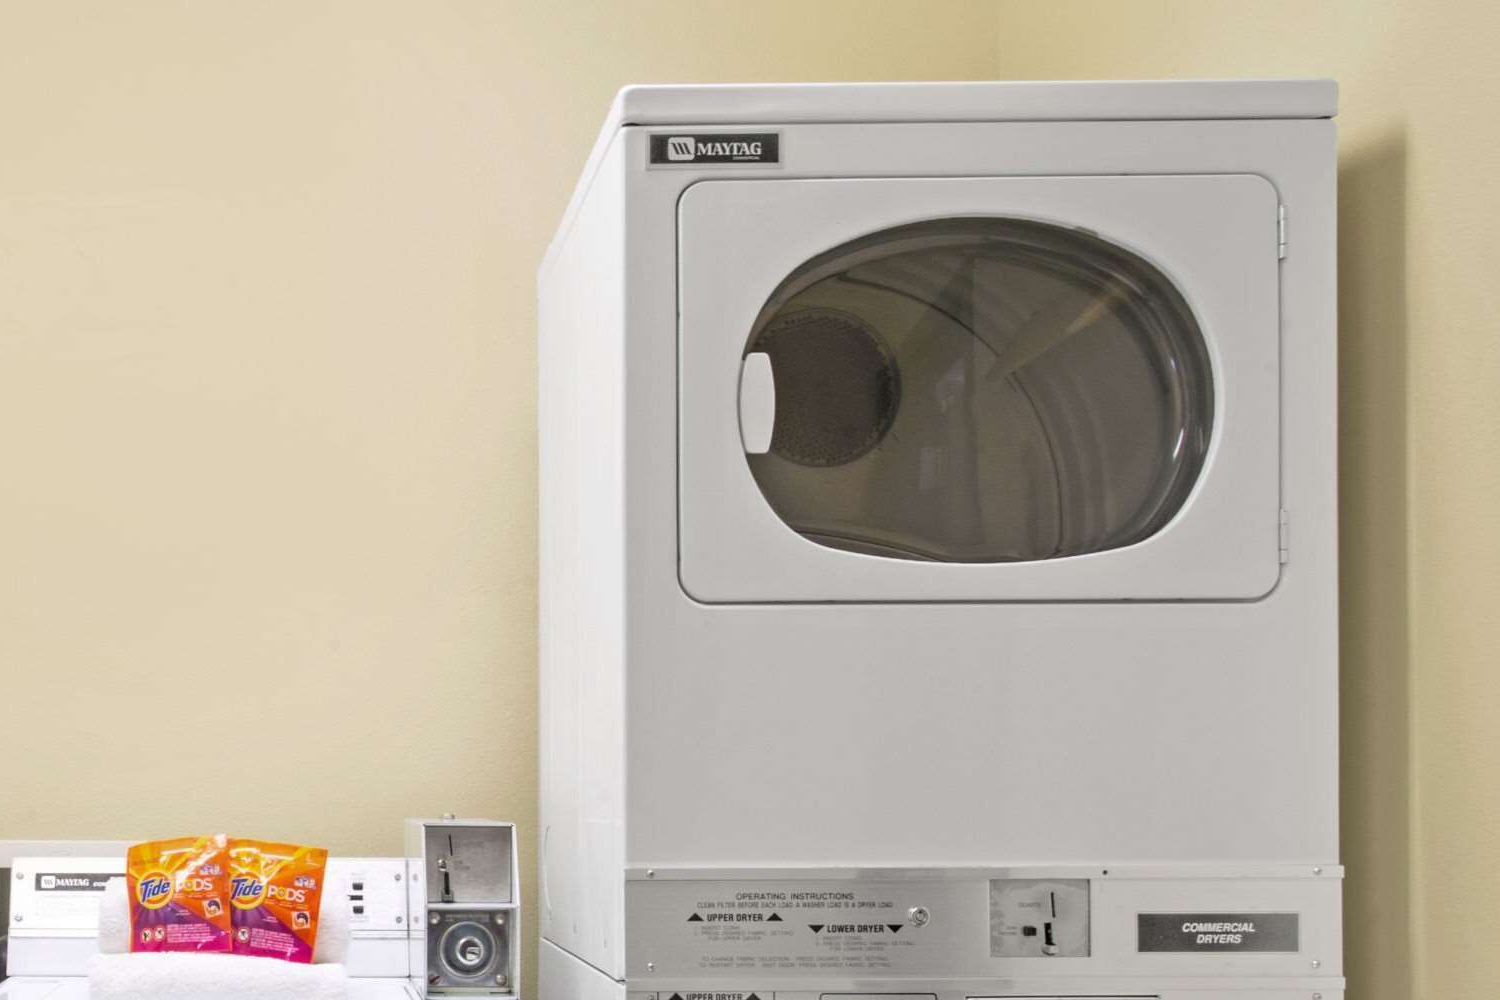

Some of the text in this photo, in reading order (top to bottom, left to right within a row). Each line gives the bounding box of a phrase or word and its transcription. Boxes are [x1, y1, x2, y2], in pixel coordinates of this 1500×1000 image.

[696, 142, 762, 156] MAYTAG
[55, 878, 90, 887] MAYTAG
[175, 877, 213, 893] PODS
[140, 877, 170, 903] Tide
[231, 878, 263, 901] Tide
[267, 884, 306, 903] PODS
[736, 892, 854, 901] OPERATING INSTRUCTIONS
[707, 913, 763, 922] UPPER DRYER
[827, 924, 884, 933] LOWER DRYER
[1182, 922, 1255, 933] COMMERCIAL
[1196, 934, 1243, 944] DRYERS
